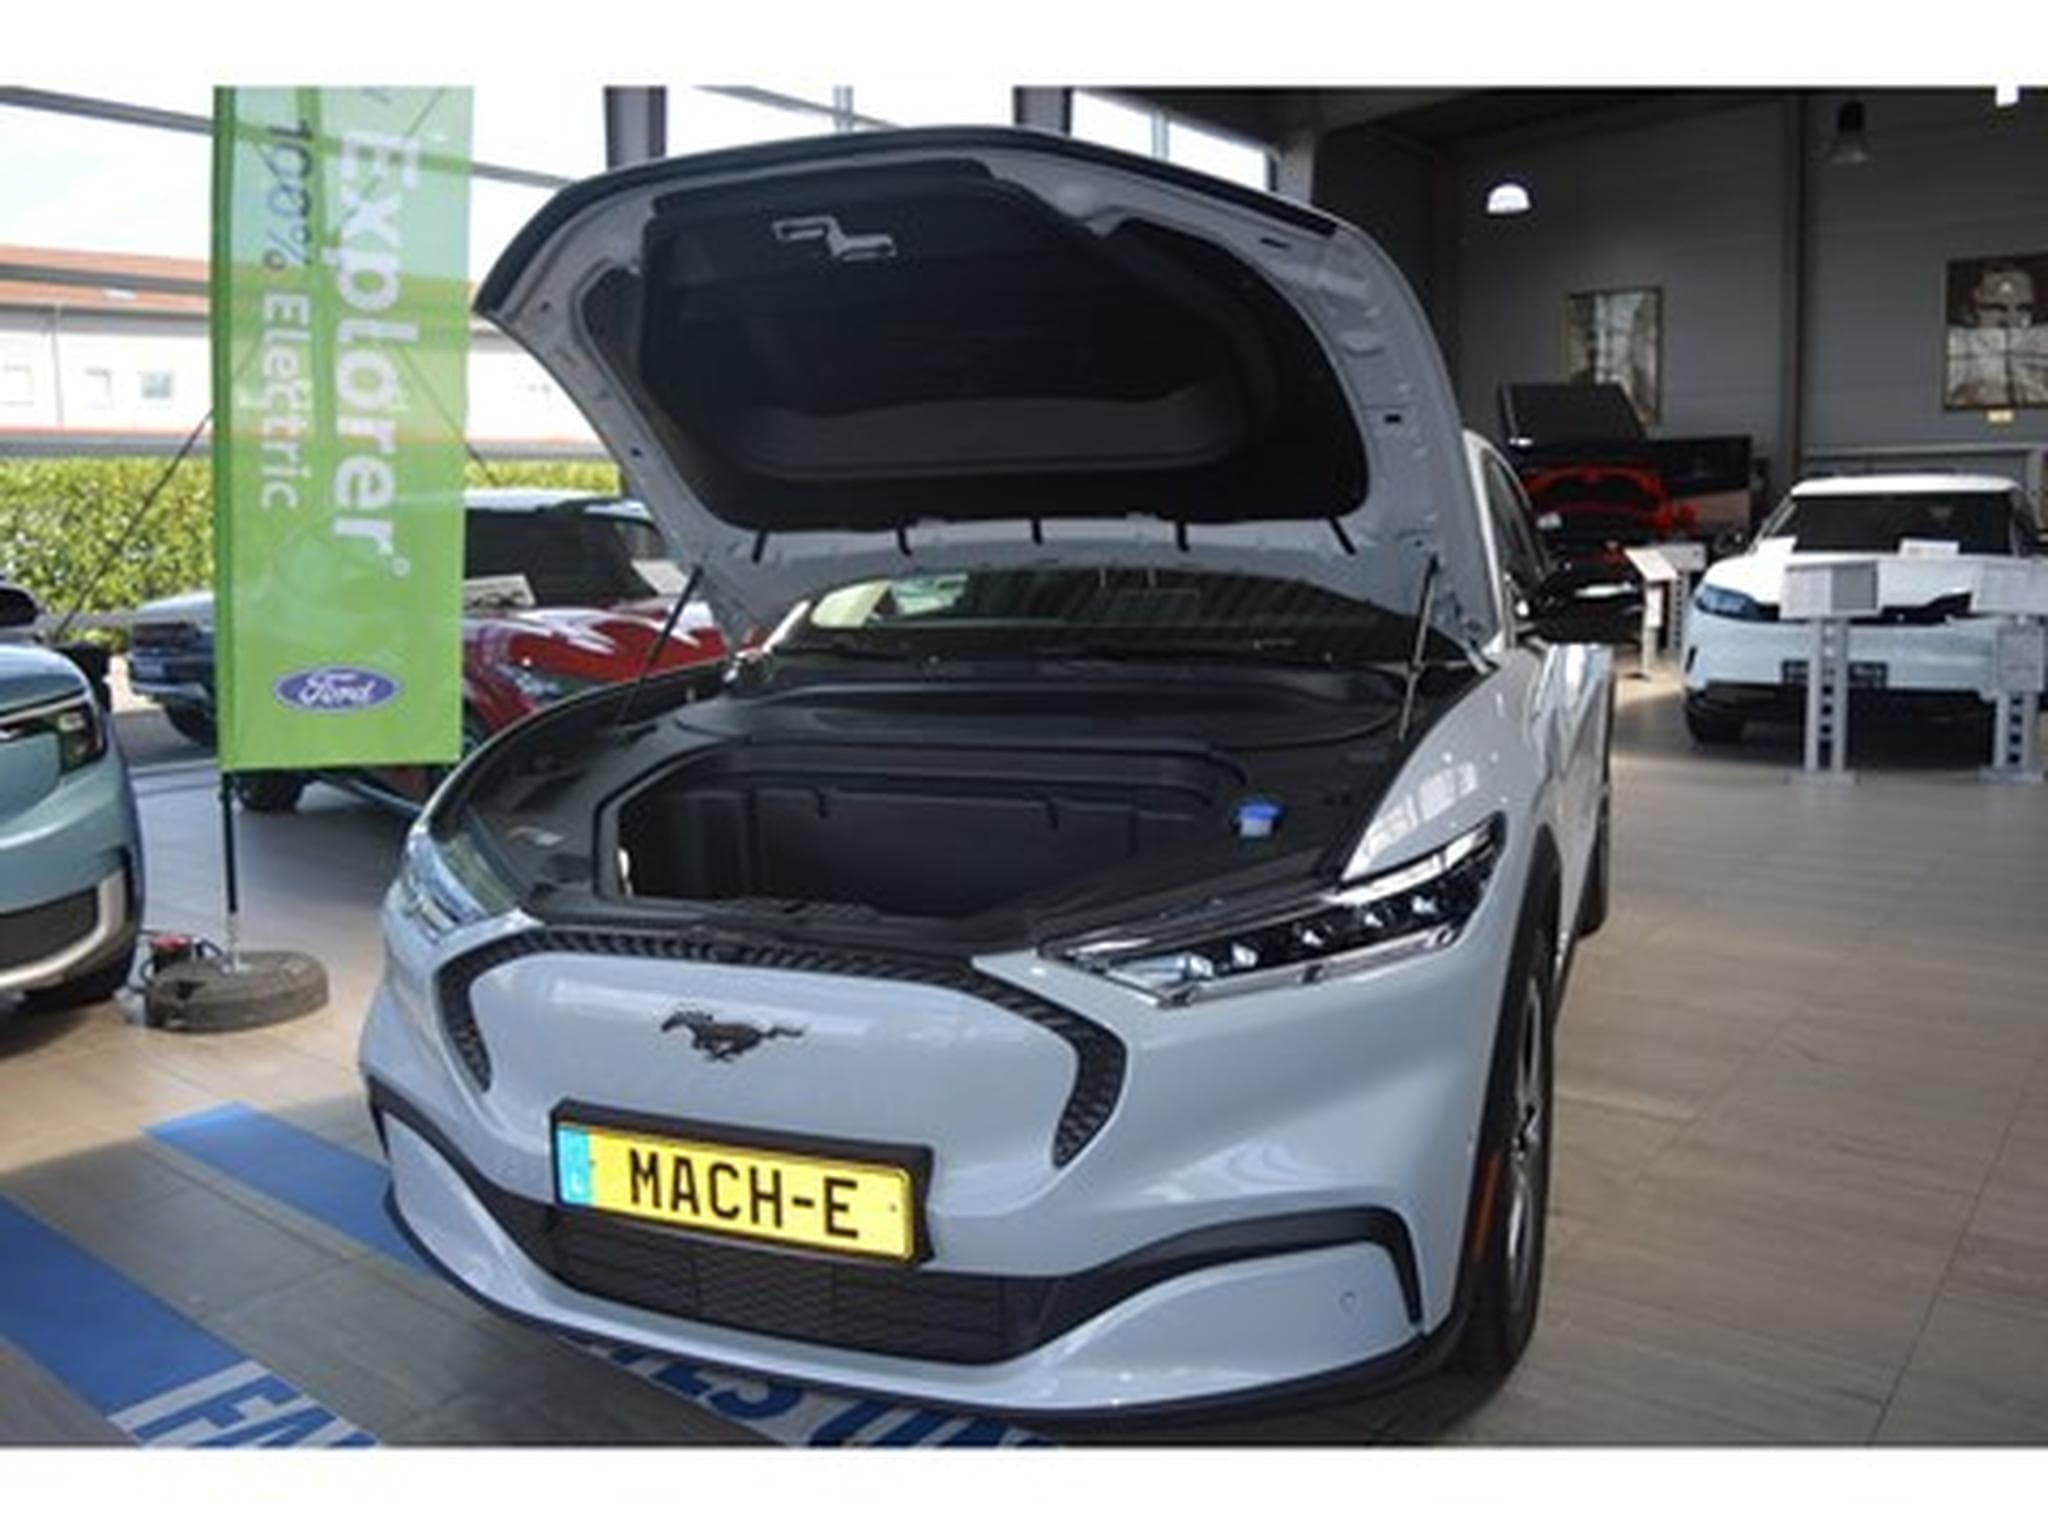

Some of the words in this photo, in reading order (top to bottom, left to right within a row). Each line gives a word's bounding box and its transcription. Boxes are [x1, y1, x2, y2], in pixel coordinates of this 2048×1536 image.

[263, 118, 312, 271] 100%
[261, 290, 311, 508] Electric
[300, 672, 377, 706] Ford
[628, 1147, 859, 1239] MACH-E
